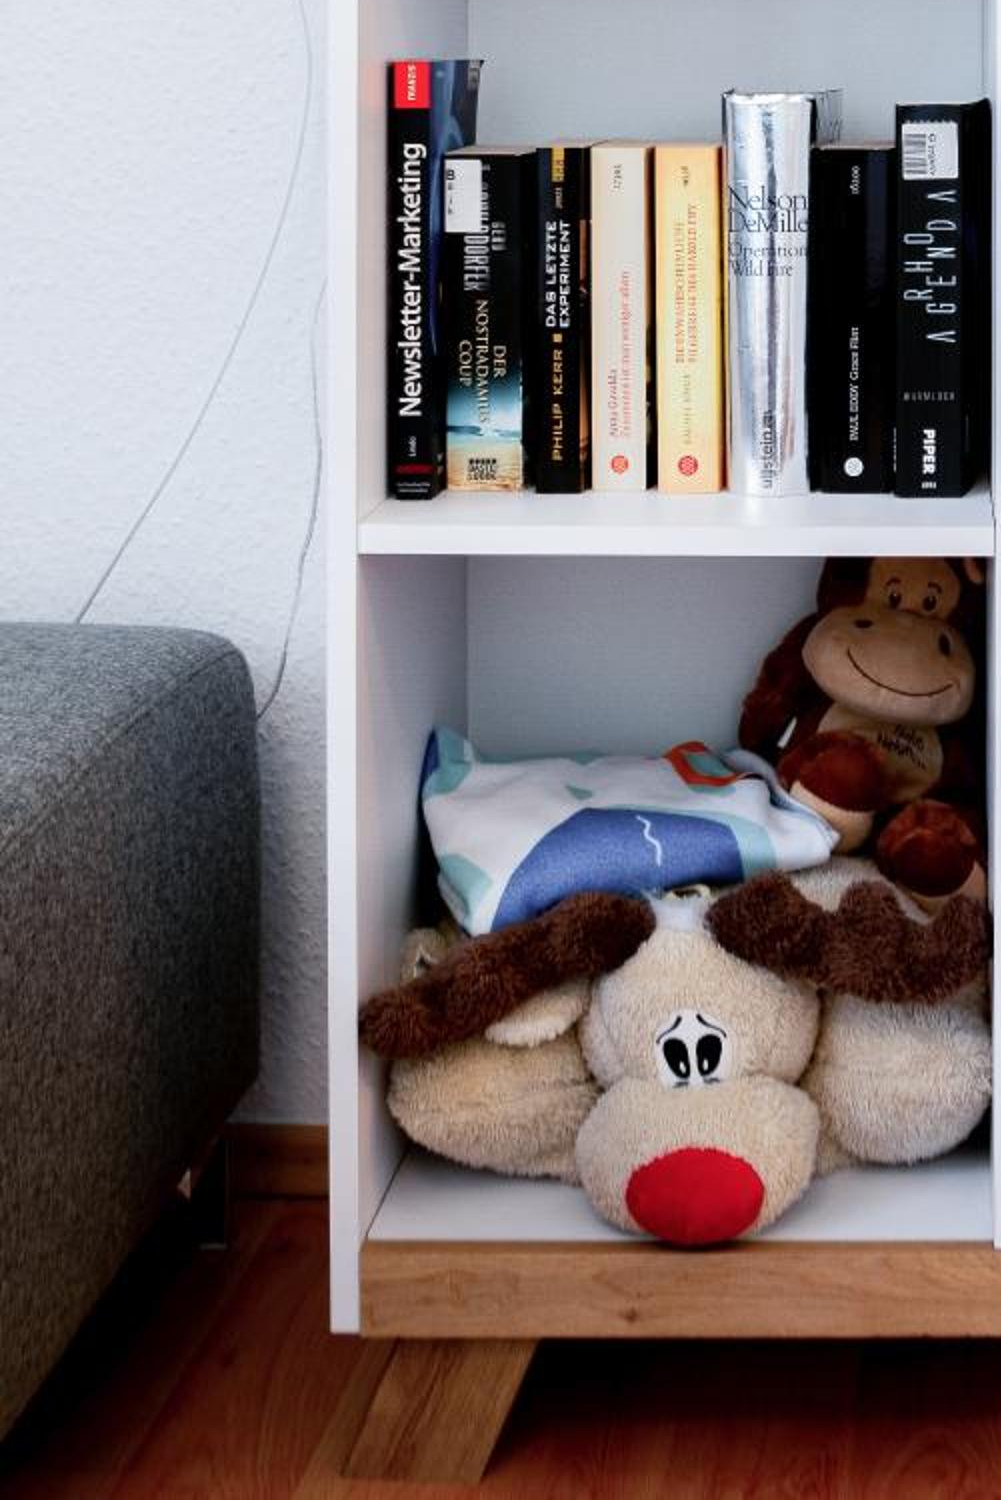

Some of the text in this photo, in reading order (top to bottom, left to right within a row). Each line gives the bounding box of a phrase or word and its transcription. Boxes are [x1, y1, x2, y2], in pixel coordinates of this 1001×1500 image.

[728, 185, 808, 211] Nelson
[729, 209, 808, 233] DeMille
[399, 142, 427, 417] Newsletter-Marketing
[545, 221, 557, 328] DAS LETZTE
[559, 220, 571, 328] EXPERIMENT
[459, 340, 473, 388] COUP
[476, 300, 489, 424] NOSTRADAMUS
[494, 345, 507, 378] DER
[552, 349, 564, 461] PHILIP KERR
[922, 429, 936, 475] PIPER
